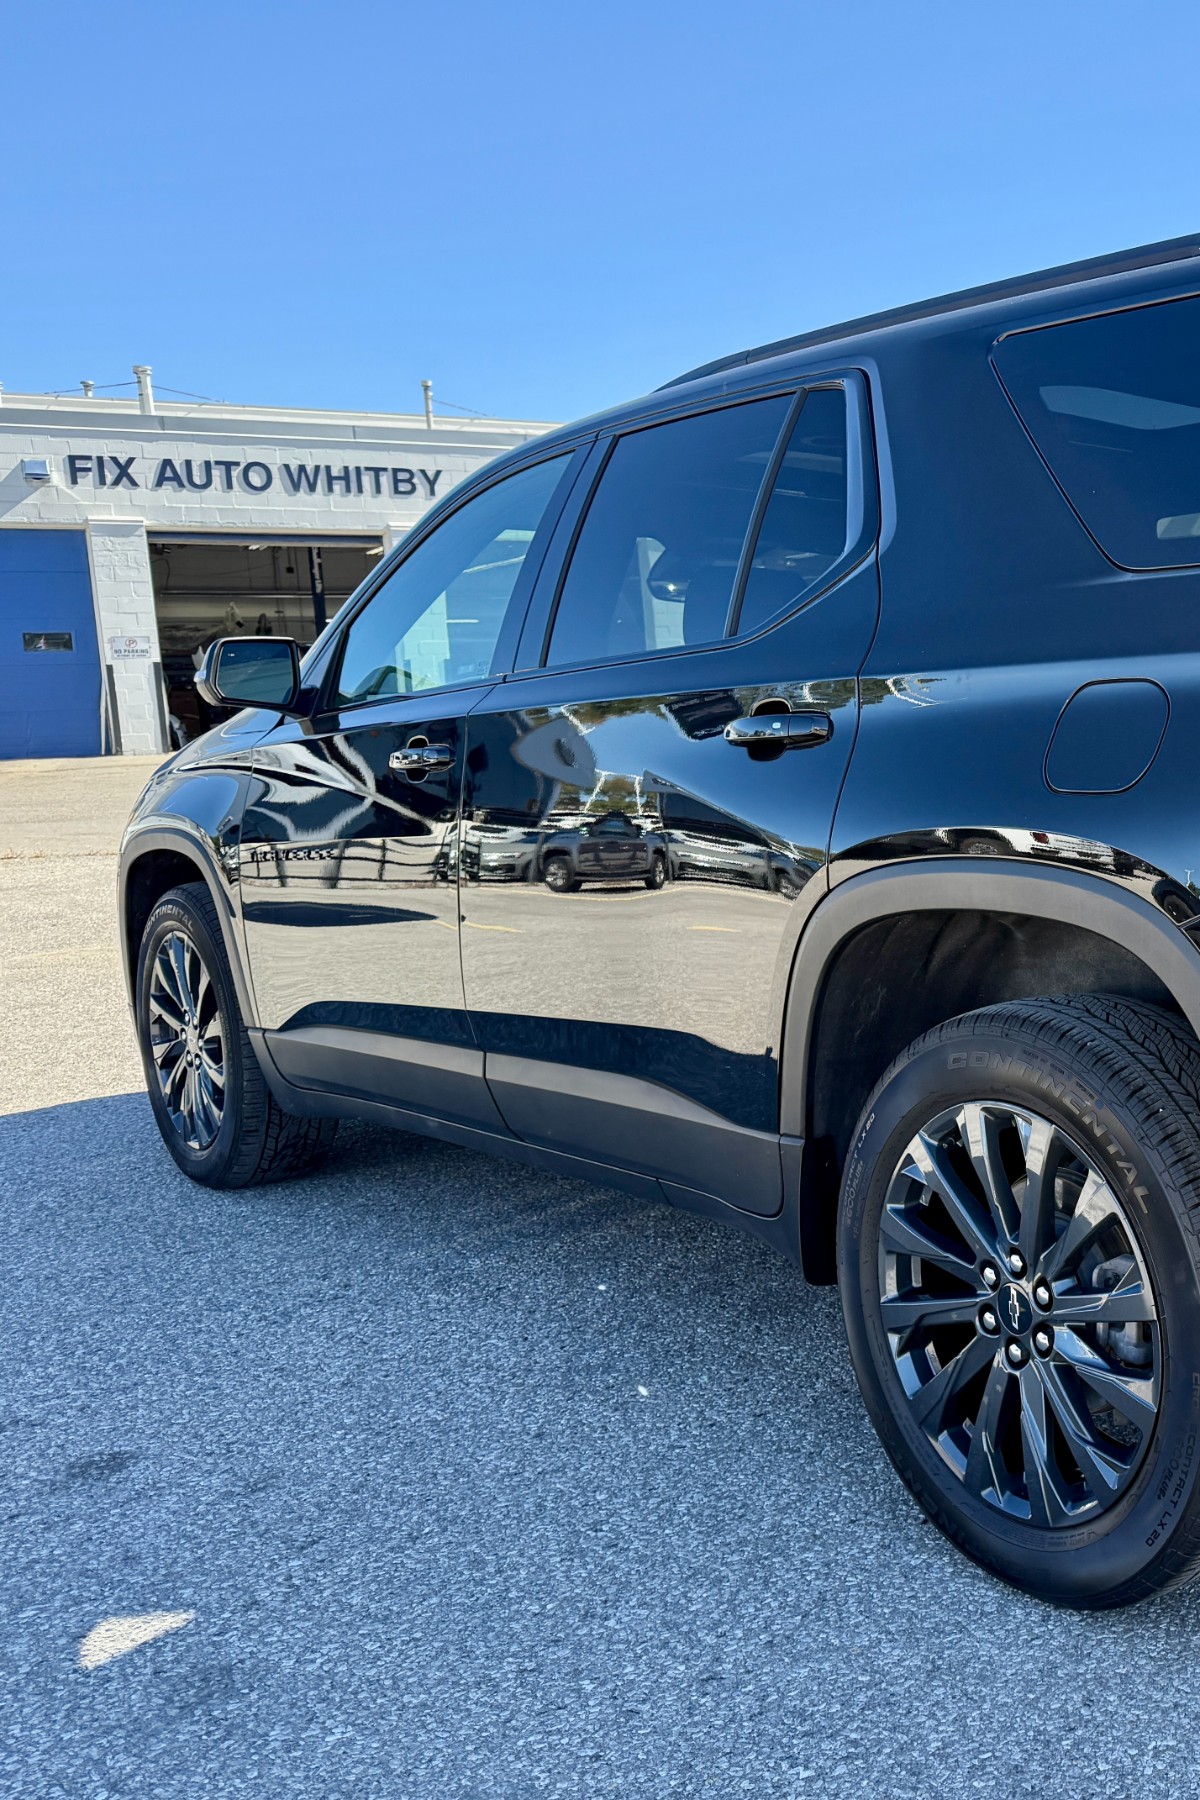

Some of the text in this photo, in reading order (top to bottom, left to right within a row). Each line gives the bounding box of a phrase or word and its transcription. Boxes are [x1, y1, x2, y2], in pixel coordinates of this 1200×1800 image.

[66, 454, 443, 496] FIX AUTO WHITBY
[947, 1051, 1149, 1214] CONTINENTAL
[1158, 1511, 1172, 1530] LX
[1145, 1530, 1160, 1547] 20
